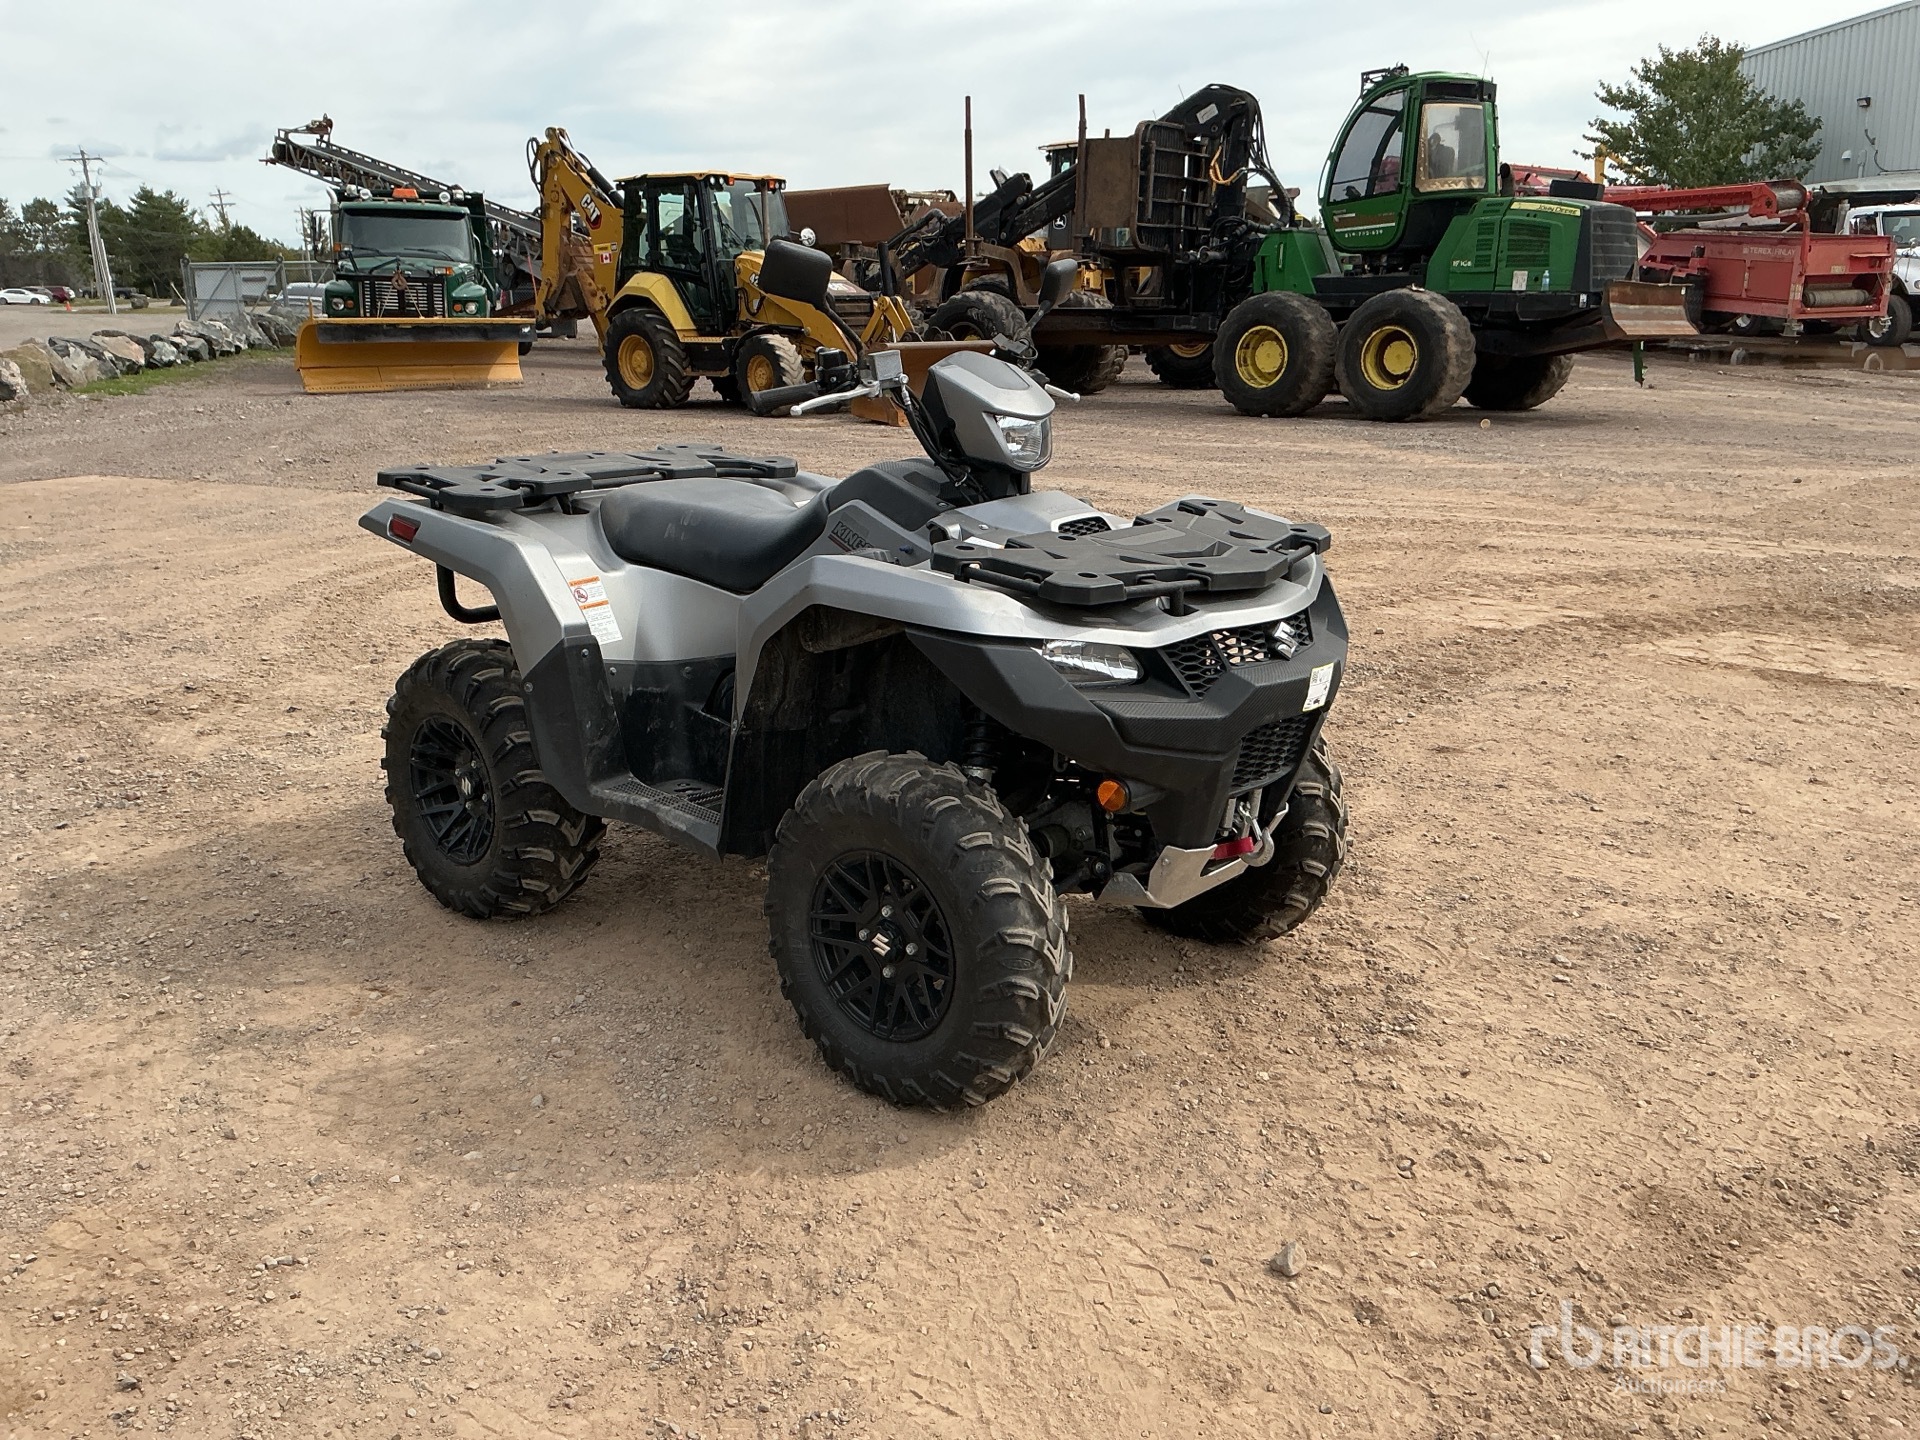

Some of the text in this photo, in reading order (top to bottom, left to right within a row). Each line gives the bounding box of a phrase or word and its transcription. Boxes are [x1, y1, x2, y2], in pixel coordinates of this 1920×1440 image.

[580, 193, 601, 223] CAT
[1750, 246, 1772, 255] TEREX
[749, 272, 760, 288] 42
